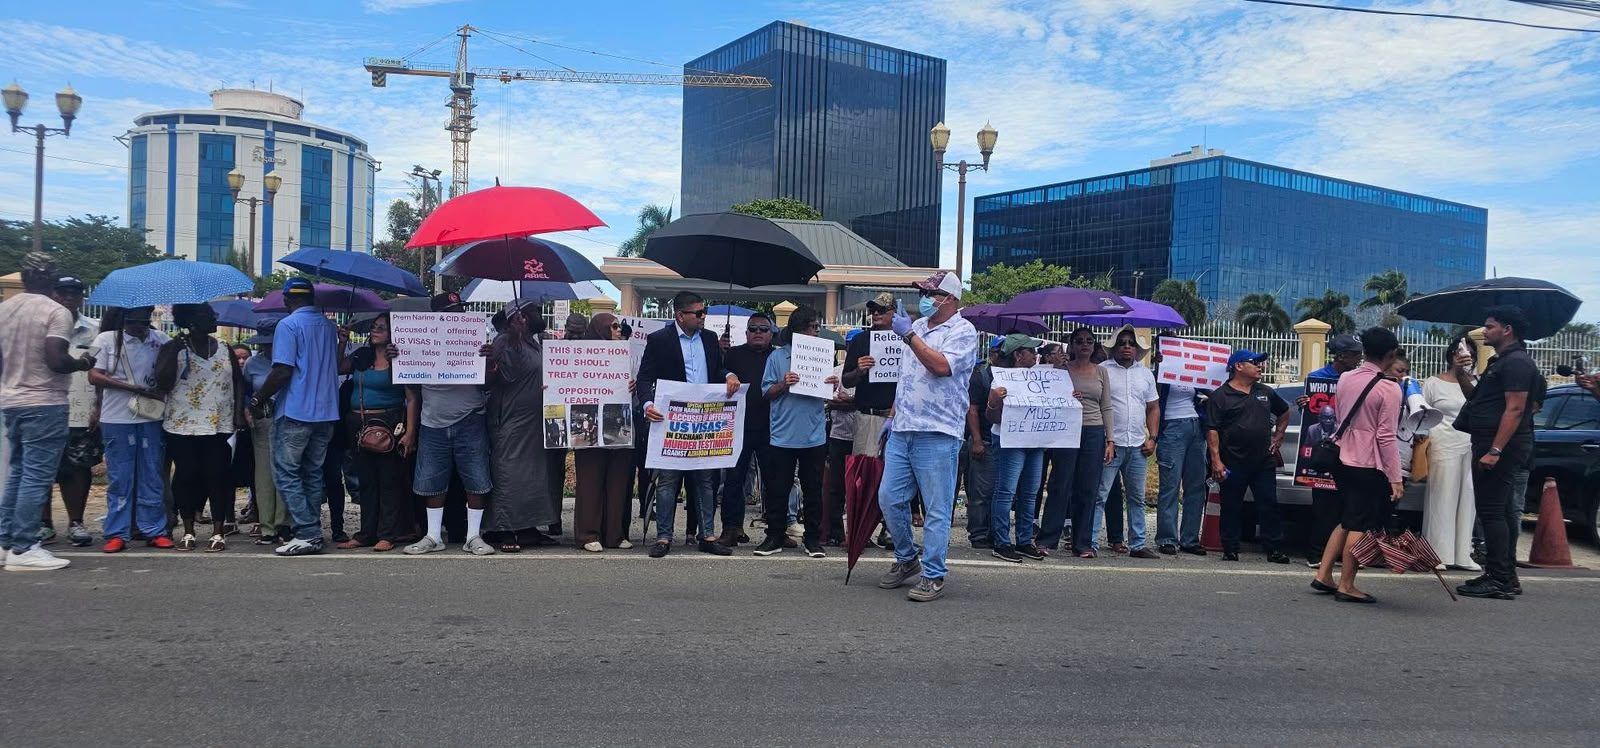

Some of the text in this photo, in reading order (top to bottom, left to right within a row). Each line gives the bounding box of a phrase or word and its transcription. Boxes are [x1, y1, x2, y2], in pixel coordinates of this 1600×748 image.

[447, 328, 477, 336] offering
[548, 346, 570, 354] THIS
[885, 346, 902, 354] the
[398, 359, 474, 368] testimony against
[548, 358, 568, 366] YOU
[1027, 381, 1050, 394] OF
[1310, 382, 1327, 392] WHO
[672, 413, 702, 422] ACCUSED
[1024, 407, 1062, 420] MUST
[669, 421, 722, 433] US VISAS
[1008, 420, 1068, 432] BE HEARD
[705, 432, 715, 440] FOR
[664, 439, 733, 449] MURDER TESTIMONY
[662, 449, 687, 457] AGAINST
